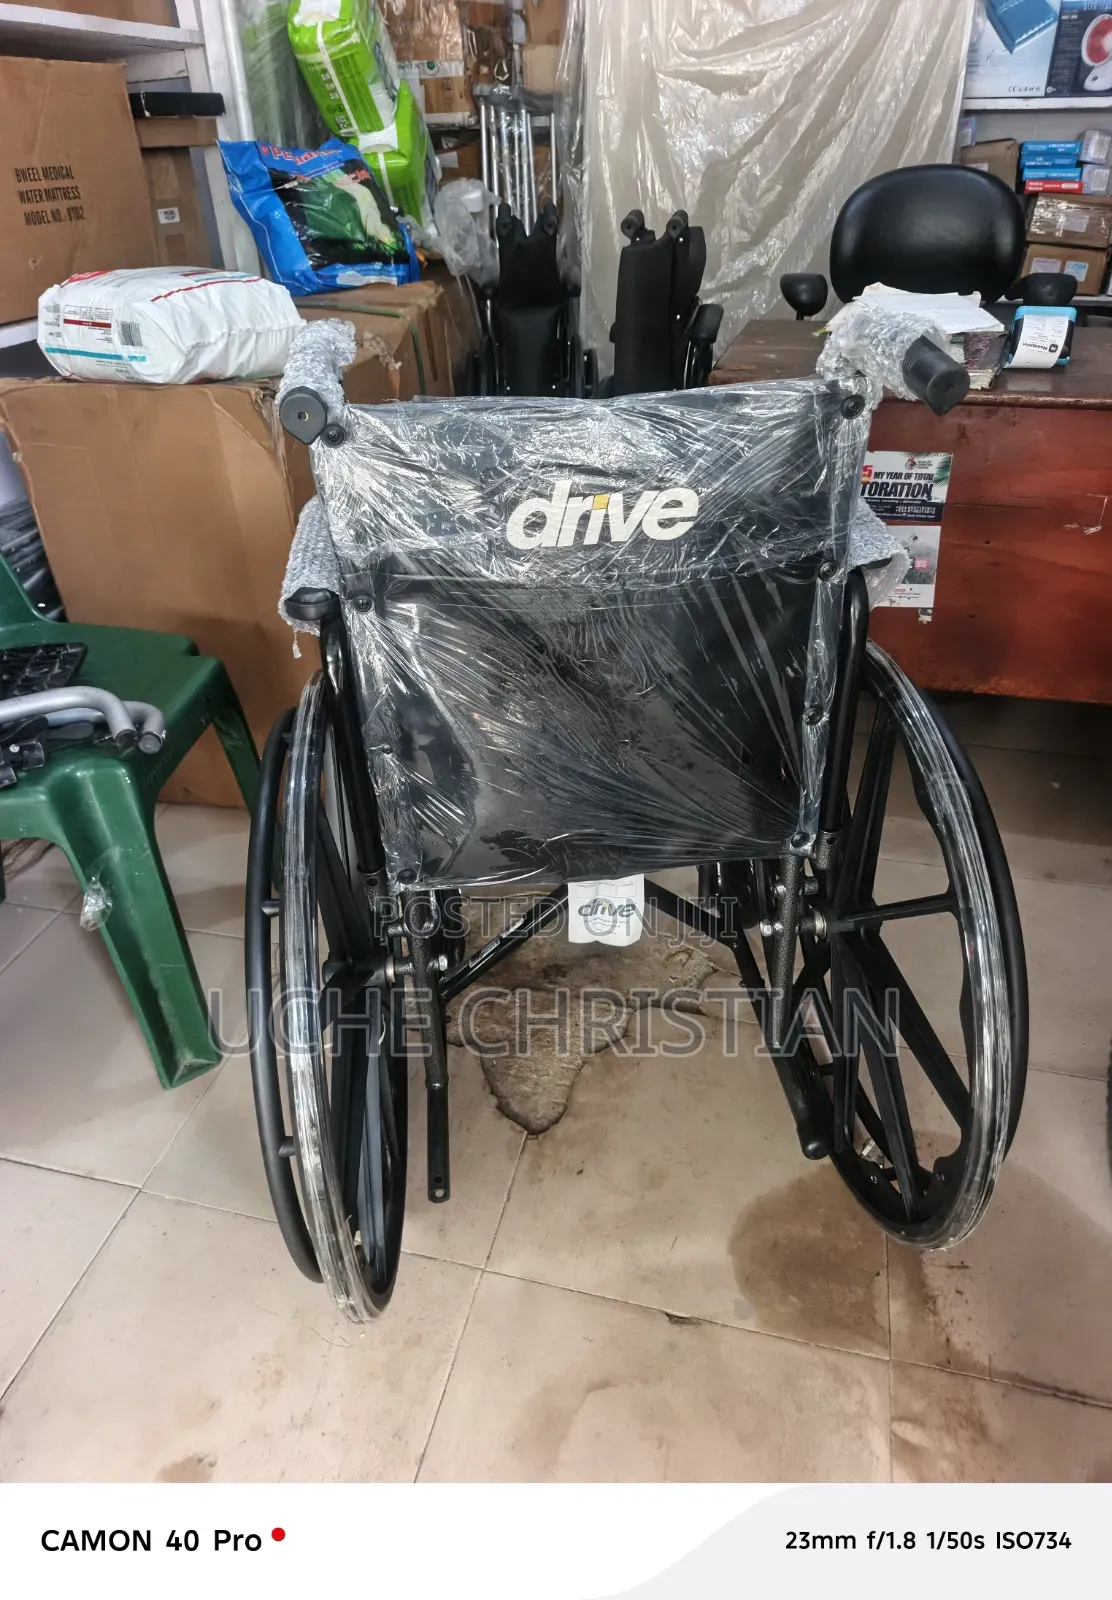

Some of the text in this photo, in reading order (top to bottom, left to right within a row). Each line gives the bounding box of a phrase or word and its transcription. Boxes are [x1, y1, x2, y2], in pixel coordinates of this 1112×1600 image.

[14, 165, 75, 183] BWEEL MEDICAL
[18, 186, 81, 204] WATER MATTRESS
[24, 211, 50, 226] MODEL
[873, 471, 885, 480] MY
[885, 472, 903, 480] YEAR
[904, 472, 914, 481] OF
[914, 473, 934, 481] TOTAL
[506, 479, 699, 550] drive
[577, 899, 636, 918] drive
